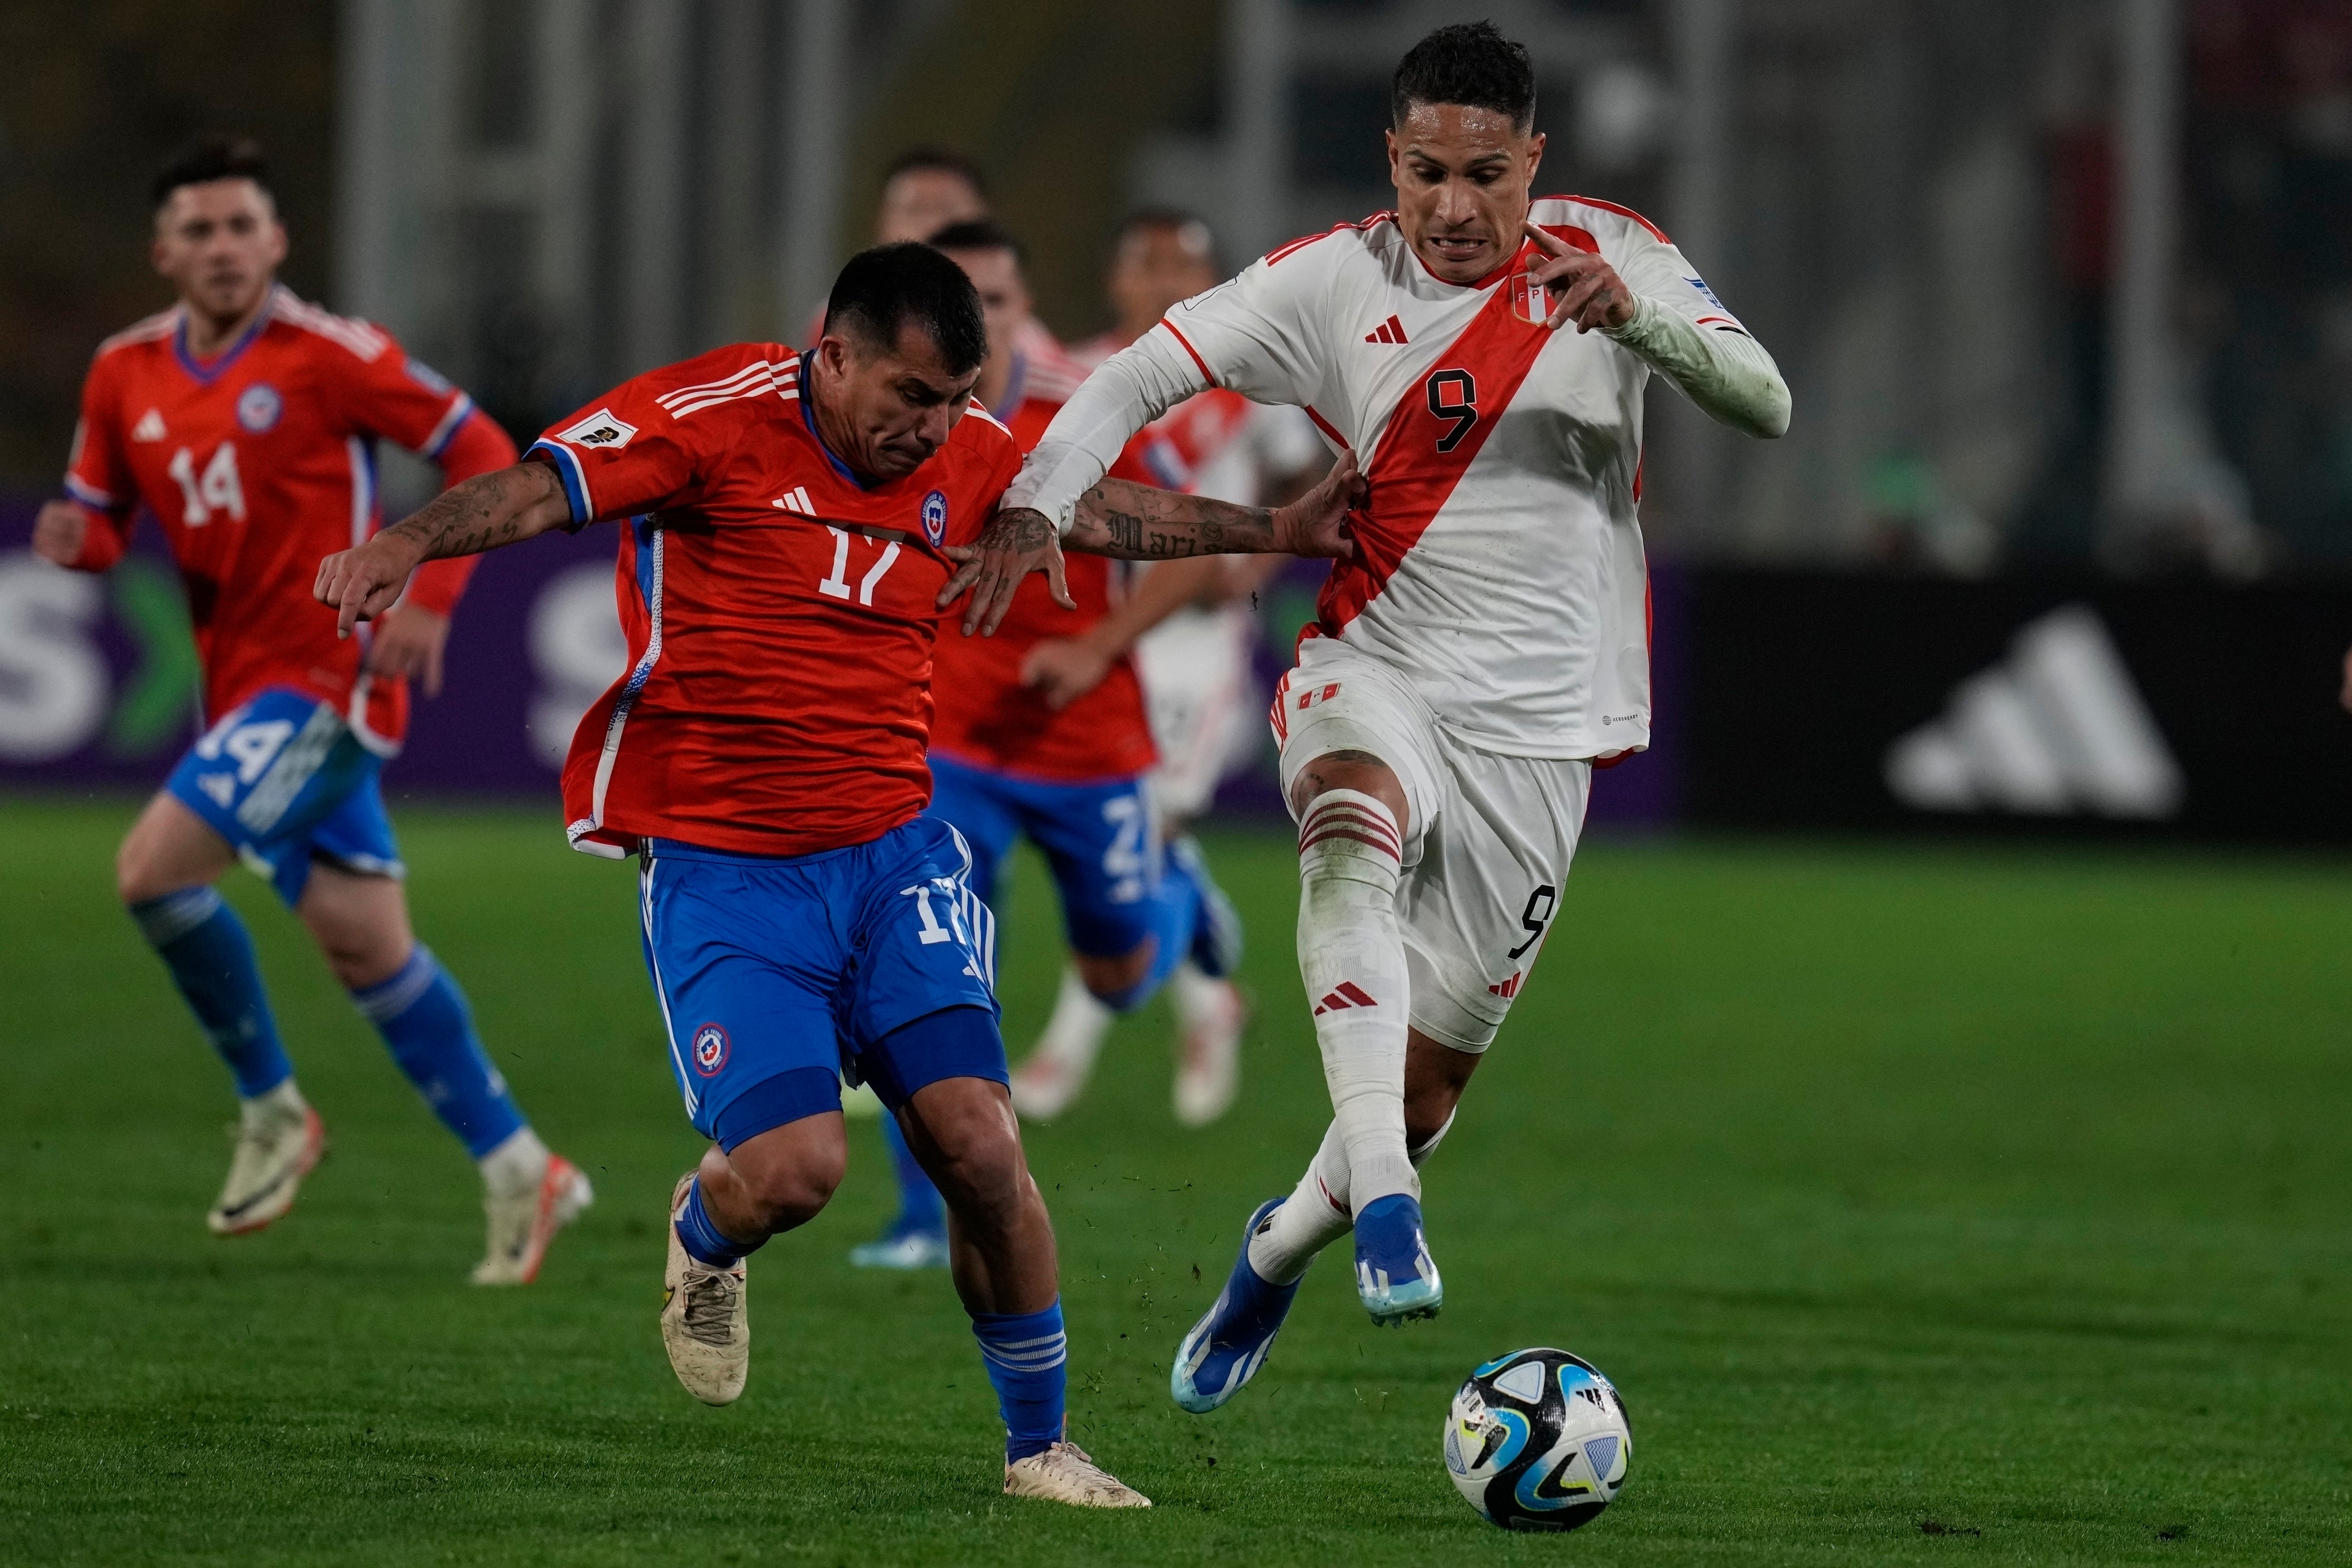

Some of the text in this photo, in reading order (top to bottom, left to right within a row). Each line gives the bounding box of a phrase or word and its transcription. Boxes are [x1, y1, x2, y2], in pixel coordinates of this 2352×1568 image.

[1426, 368, 1479, 454] 9
[168, 440, 246, 527] 14
[818, 520, 907, 607] 17
[1613, 714, 1638, 722] AEROREADY
[900, 877, 967, 946] 17
[1506, 884, 1556, 961] 9
